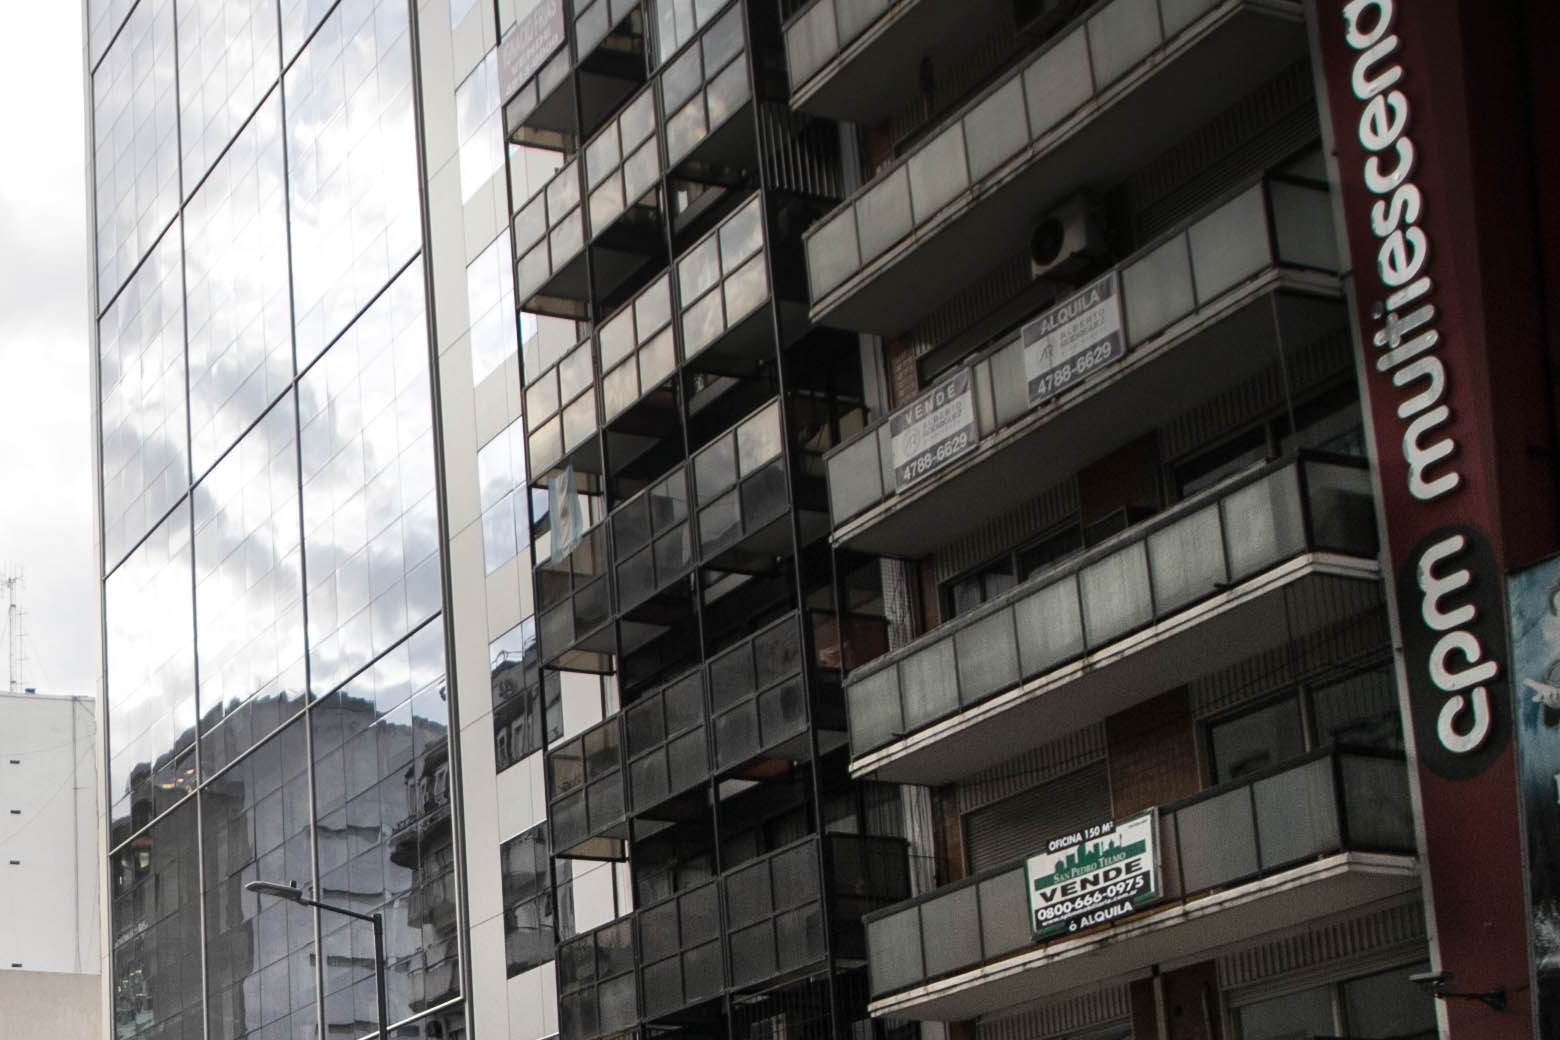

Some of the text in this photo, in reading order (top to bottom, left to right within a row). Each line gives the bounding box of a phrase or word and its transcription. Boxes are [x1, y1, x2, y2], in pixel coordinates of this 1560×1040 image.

[1041, 289, 1101, 335] ALQUILA
[1038, 342, 1112, 394] 4788-6629
[904, 384, 957, 425] VENDE
[903, 432, 968, 480] 4788-6629
[1417, 533, 1497, 754] cpm
[1049, 833, 1083, 851] OFICINA
[1085, 825, 1100, 839] 150
[1037, 875, 1145, 921] 0800-666-0975
[1040, 857, 1143, 904] VENDE
[1080, 901, 1133, 929] ALQUILA
